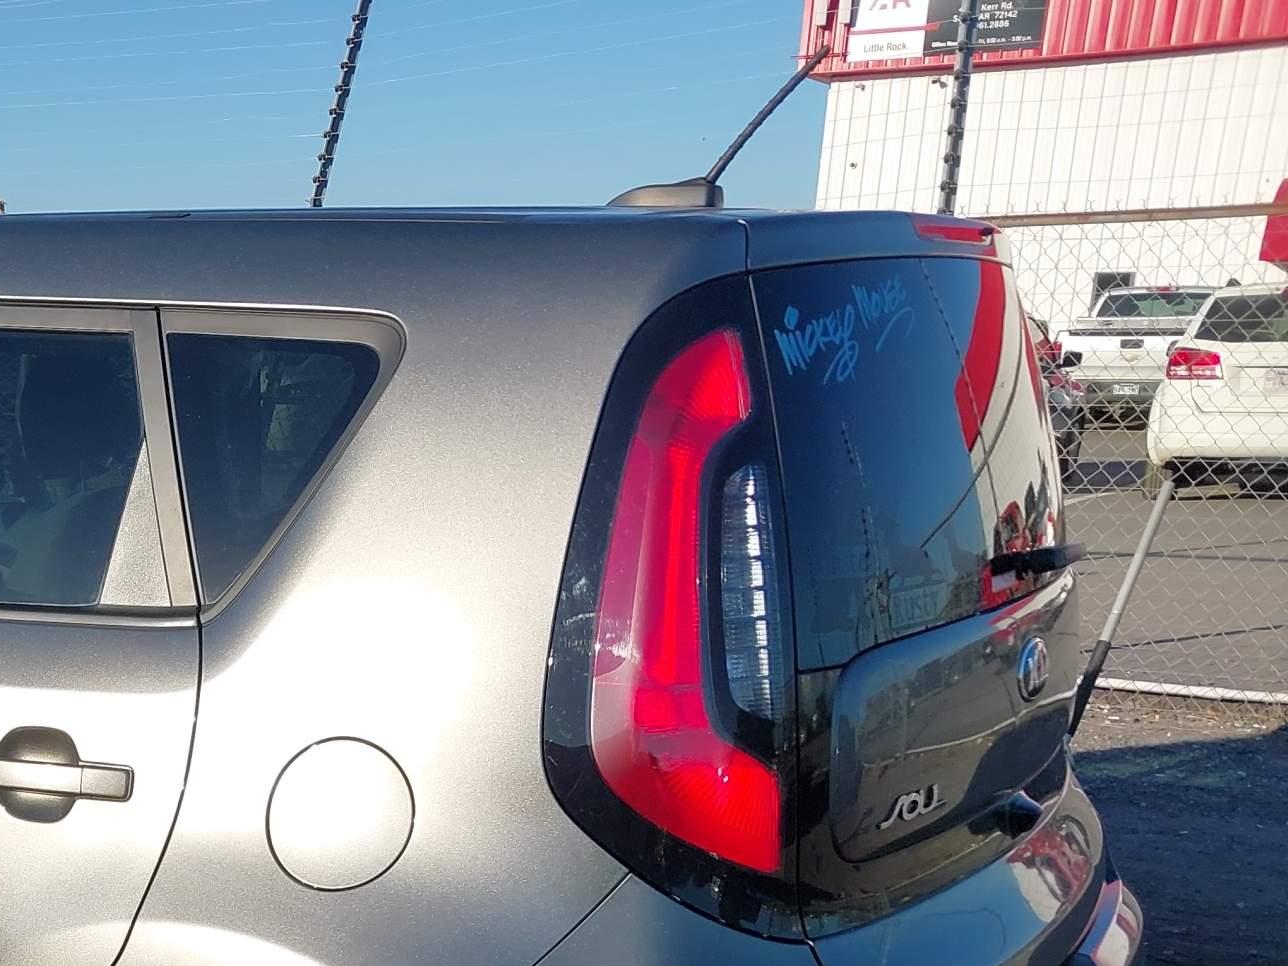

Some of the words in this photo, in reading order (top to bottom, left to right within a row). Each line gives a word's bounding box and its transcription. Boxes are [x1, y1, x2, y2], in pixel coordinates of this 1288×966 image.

[981, 3, 999, 11] Kerr
[1001, 1, 1014, 9] Rd.
[978, 12, 990, 20] AR
[994, 10, 1018, 19] 72142
[863, 44, 884, 53] Little
[886, 42, 907, 51] Rock
